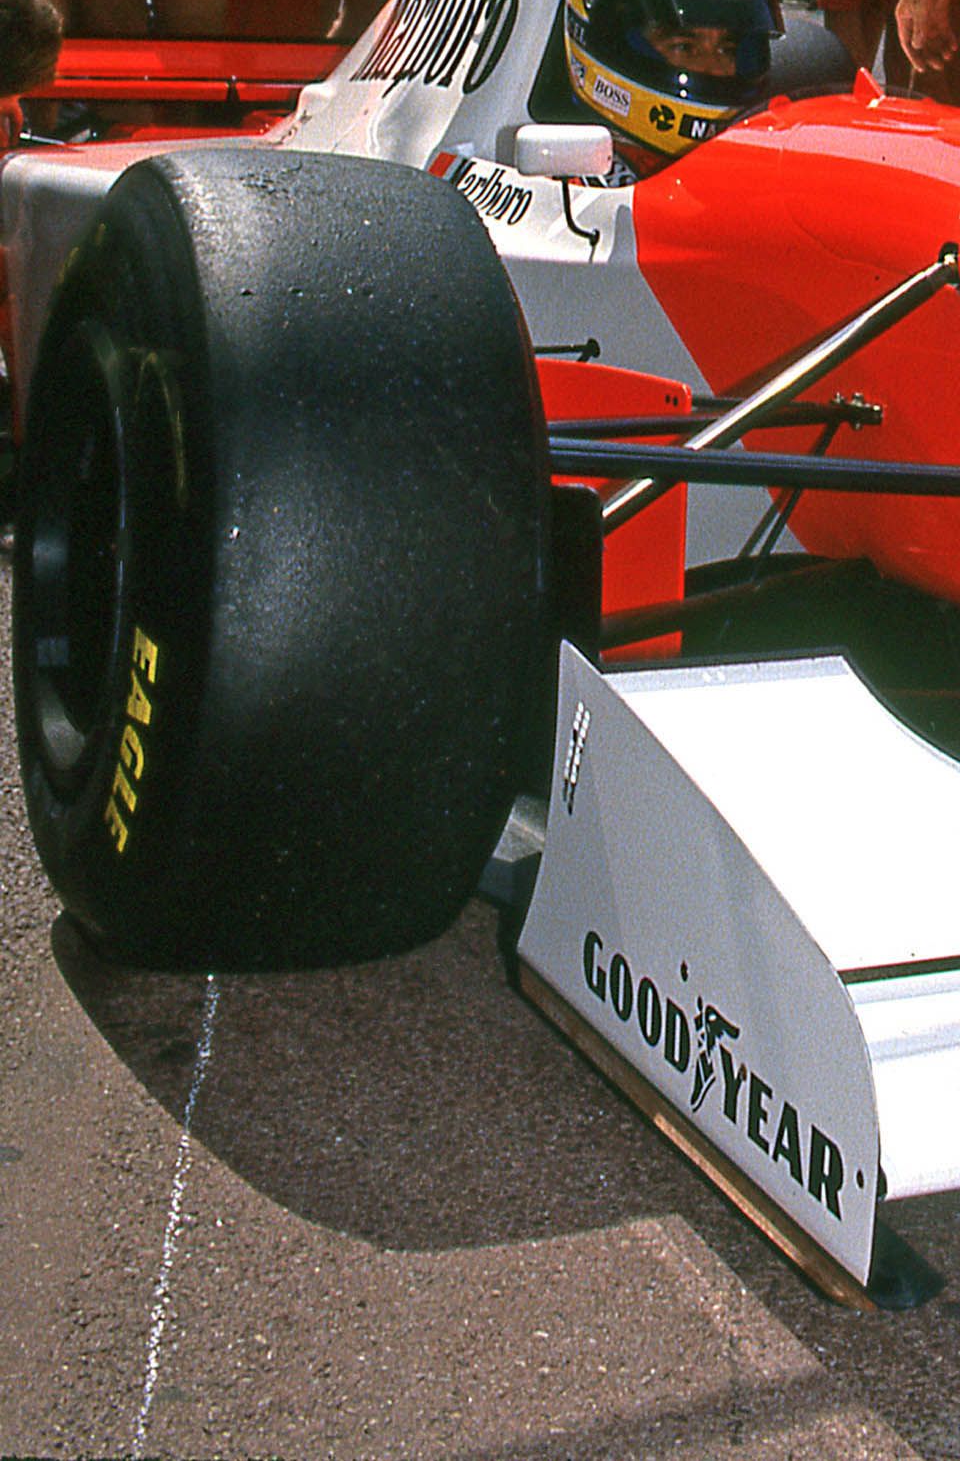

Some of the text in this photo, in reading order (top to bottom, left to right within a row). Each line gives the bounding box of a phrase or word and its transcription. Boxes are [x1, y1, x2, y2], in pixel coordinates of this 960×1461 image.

[595, 79, 630, 107] BOSS
[450, 157, 533, 226] Marlboro
[101, 627, 159, 853] EAGLE
[583, 930, 845, 1221] GOODYEAR
